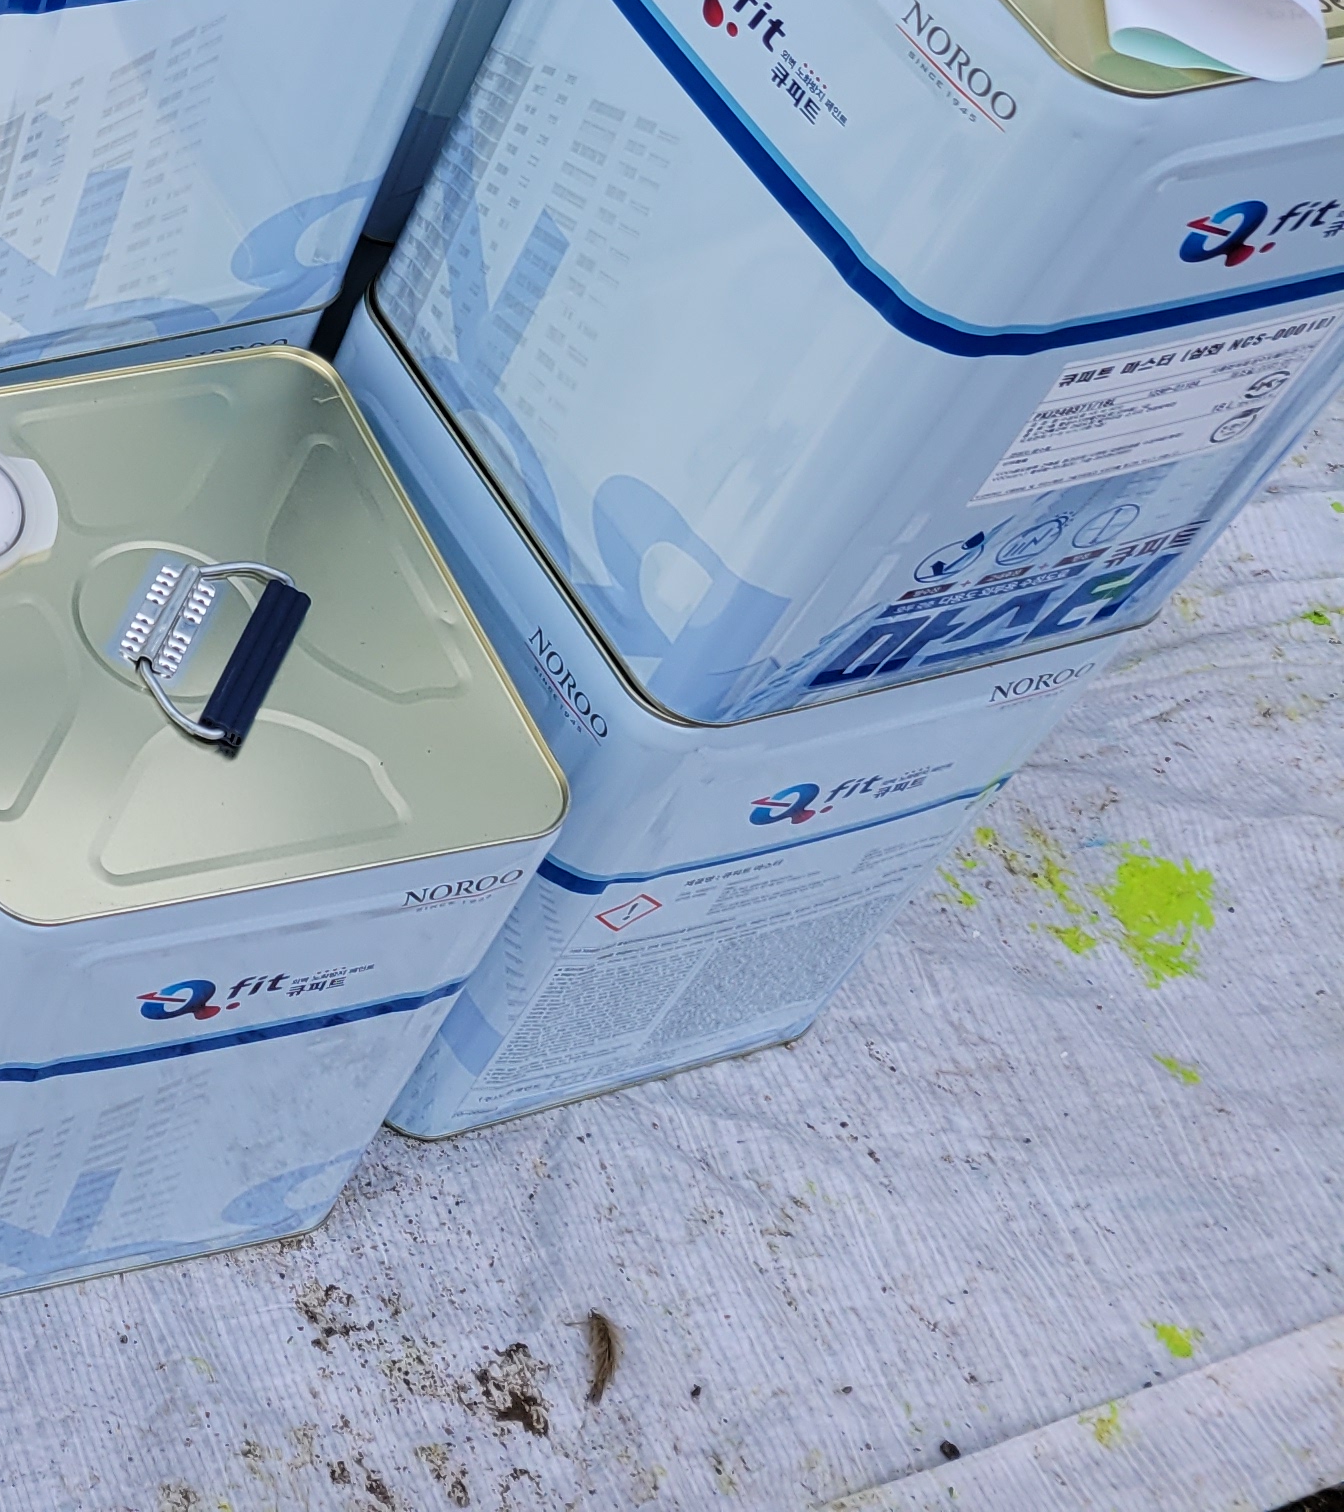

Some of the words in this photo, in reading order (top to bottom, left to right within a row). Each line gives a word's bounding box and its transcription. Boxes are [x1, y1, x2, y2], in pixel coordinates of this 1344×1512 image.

[901, 0, 1017, 121] NOROO
[769, 61, 822, 125] 큐피트
[907, 50, 944, 89] SINCE
[944, 90, 978, 123] 1945
[824, 96, 849, 128] 페인트
[1268, 199, 1337, 236] fit
[1059, 365, 1116, 388] 큐피트
[1119, 352, 1178, 375] 마스터
[1103, 523, 1210, 569] 큐피트
[807, 553, 1183, 688] 마스터
[528, 625, 609, 739] NOROO
[989, 662, 1096, 703] NOROO
[823, 774, 883, 803] fit
[402, 869, 524, 907] NOROO
[226, 972, 291, 1000] fit
[287, 976, 348, 998] 큐피트
